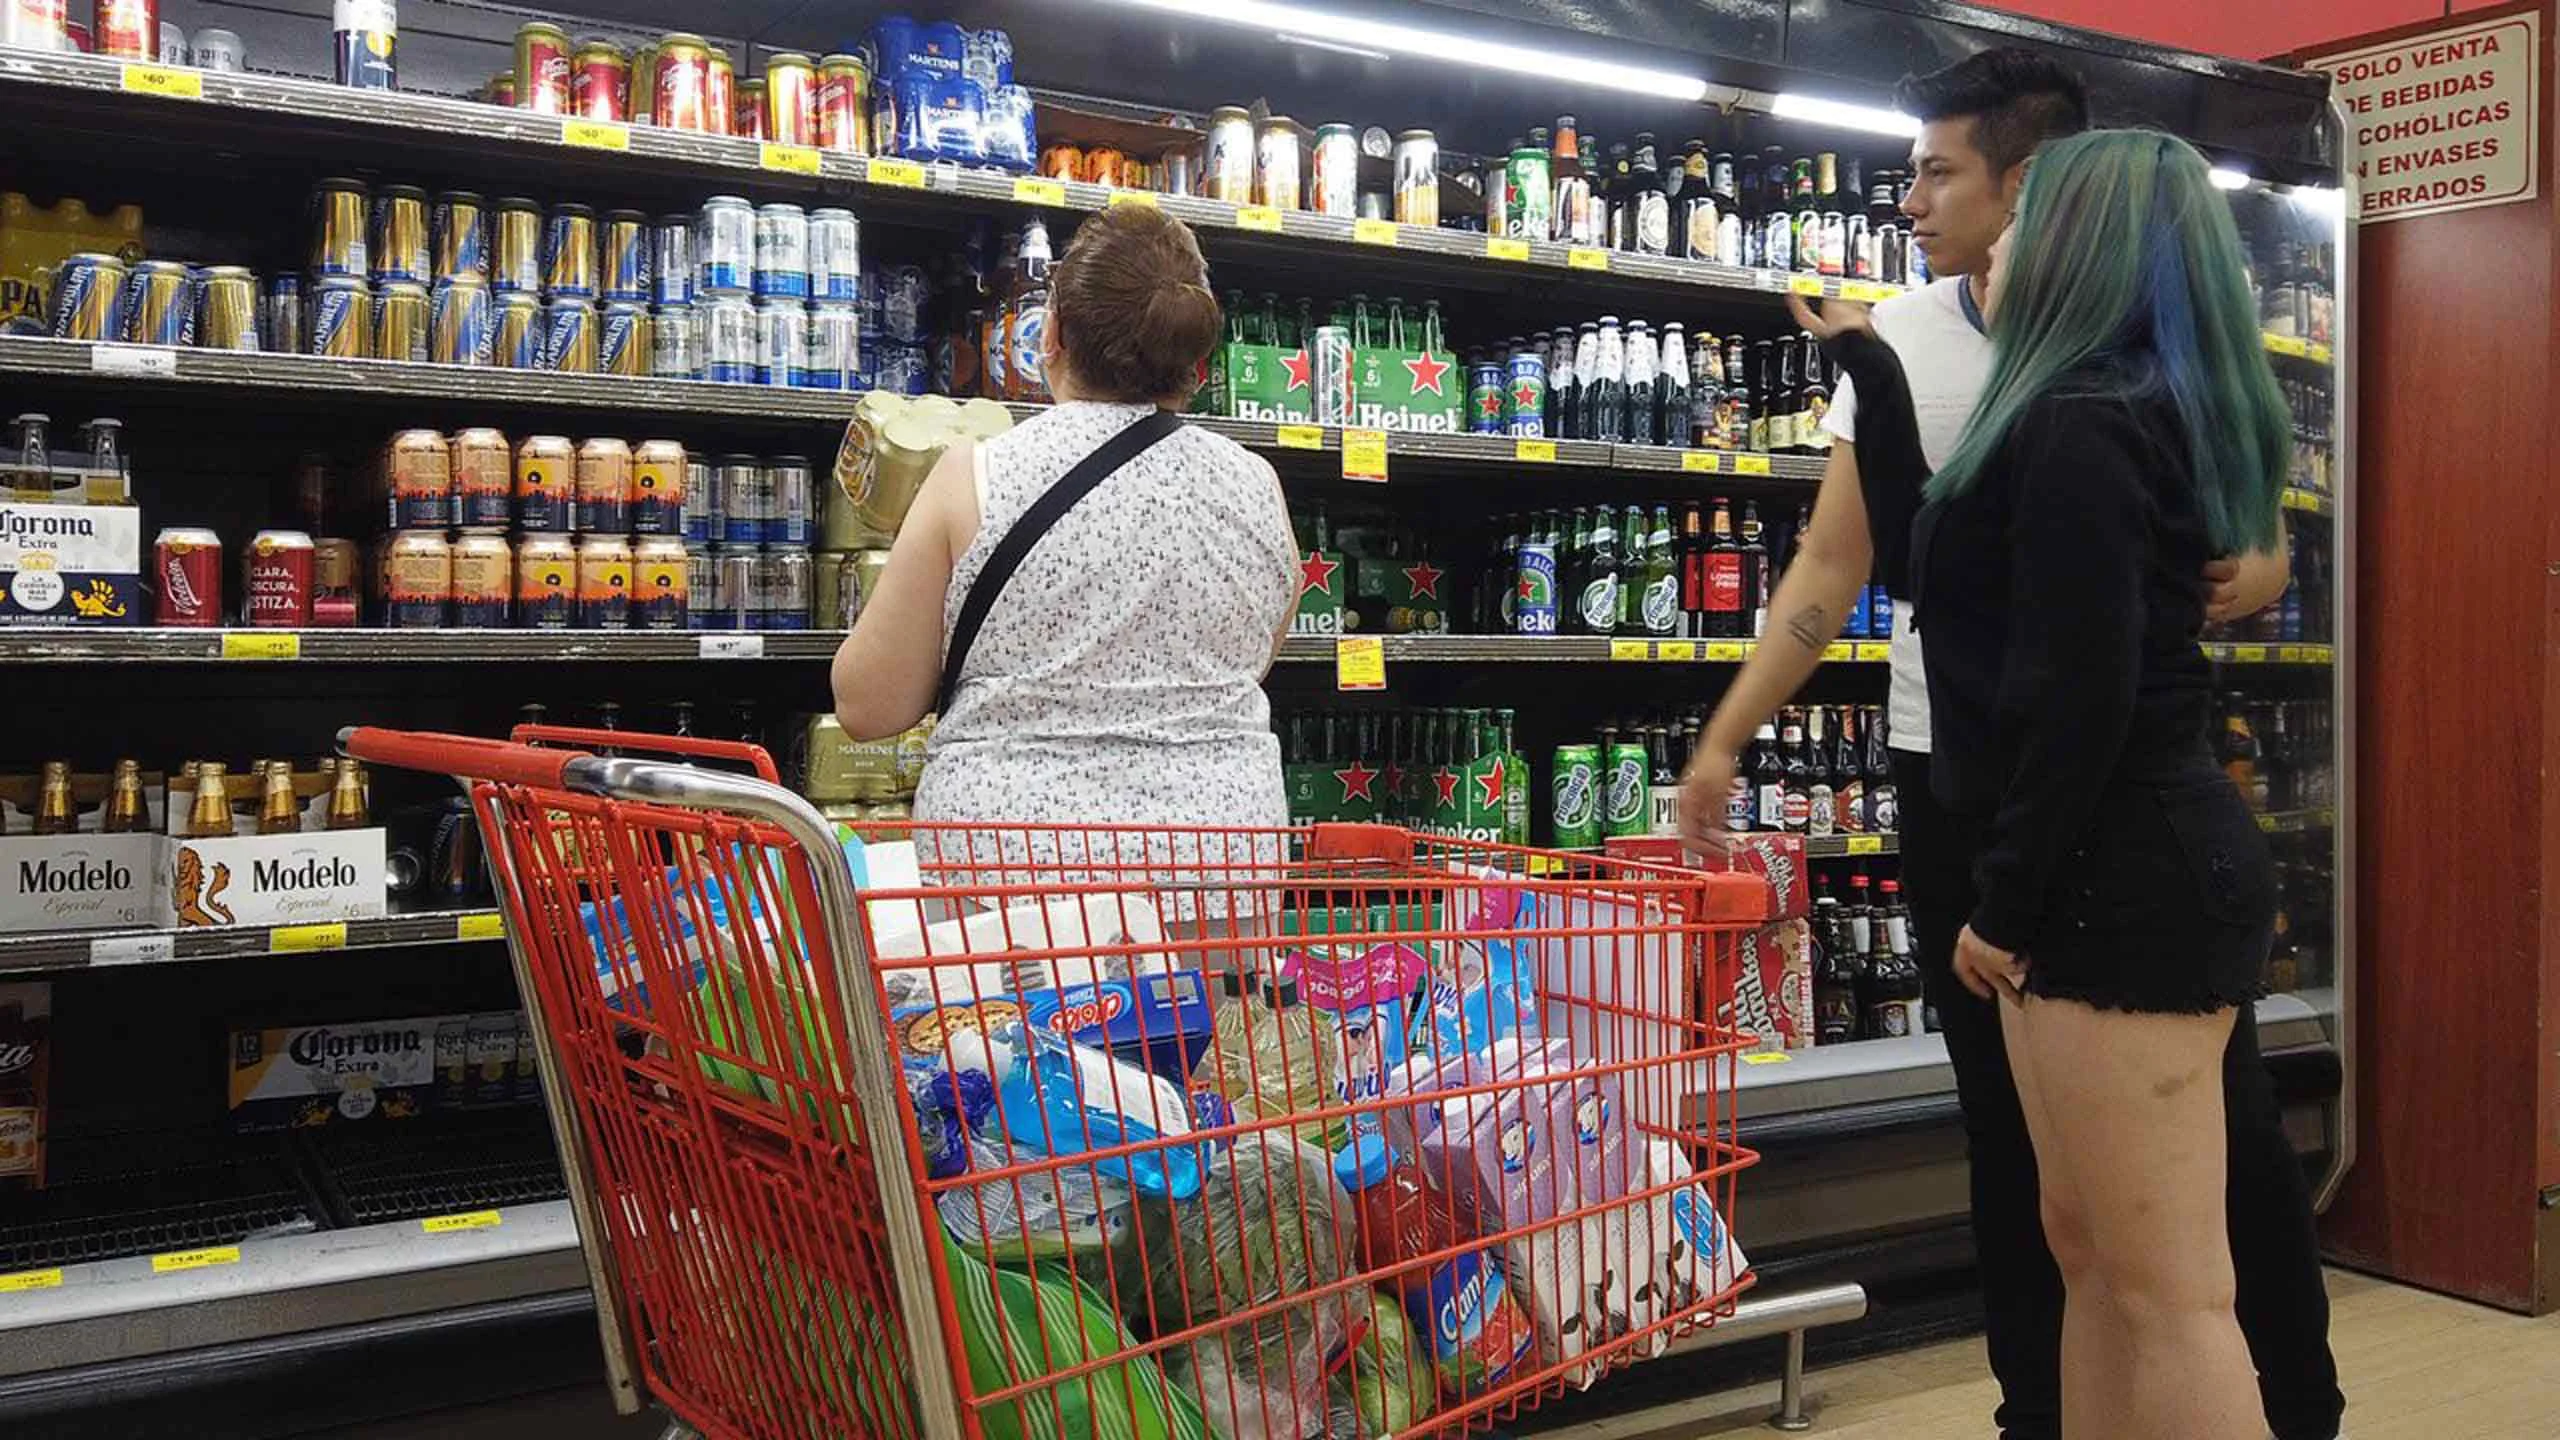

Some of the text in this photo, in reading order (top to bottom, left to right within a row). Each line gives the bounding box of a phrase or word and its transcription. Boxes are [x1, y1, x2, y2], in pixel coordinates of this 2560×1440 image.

[2336, 35, 2500, 85] SOLO VENTA
[2382, 70, 2495, 108] BEBIDAS
[2359, 101, 2511, 146] COHÓLICAS
[2378, 137, 2499, 177] ENVASES
[2363, 174, 2487, 211] ERRADOS
[19, 535, 57, 549] Extra
[19, 859, 131, 894] Modelo
[252, 856, 356, 893] Modelo
[289, 1027, 422, 1068] Corona
[334, 1060, 379, 1075] Extra
